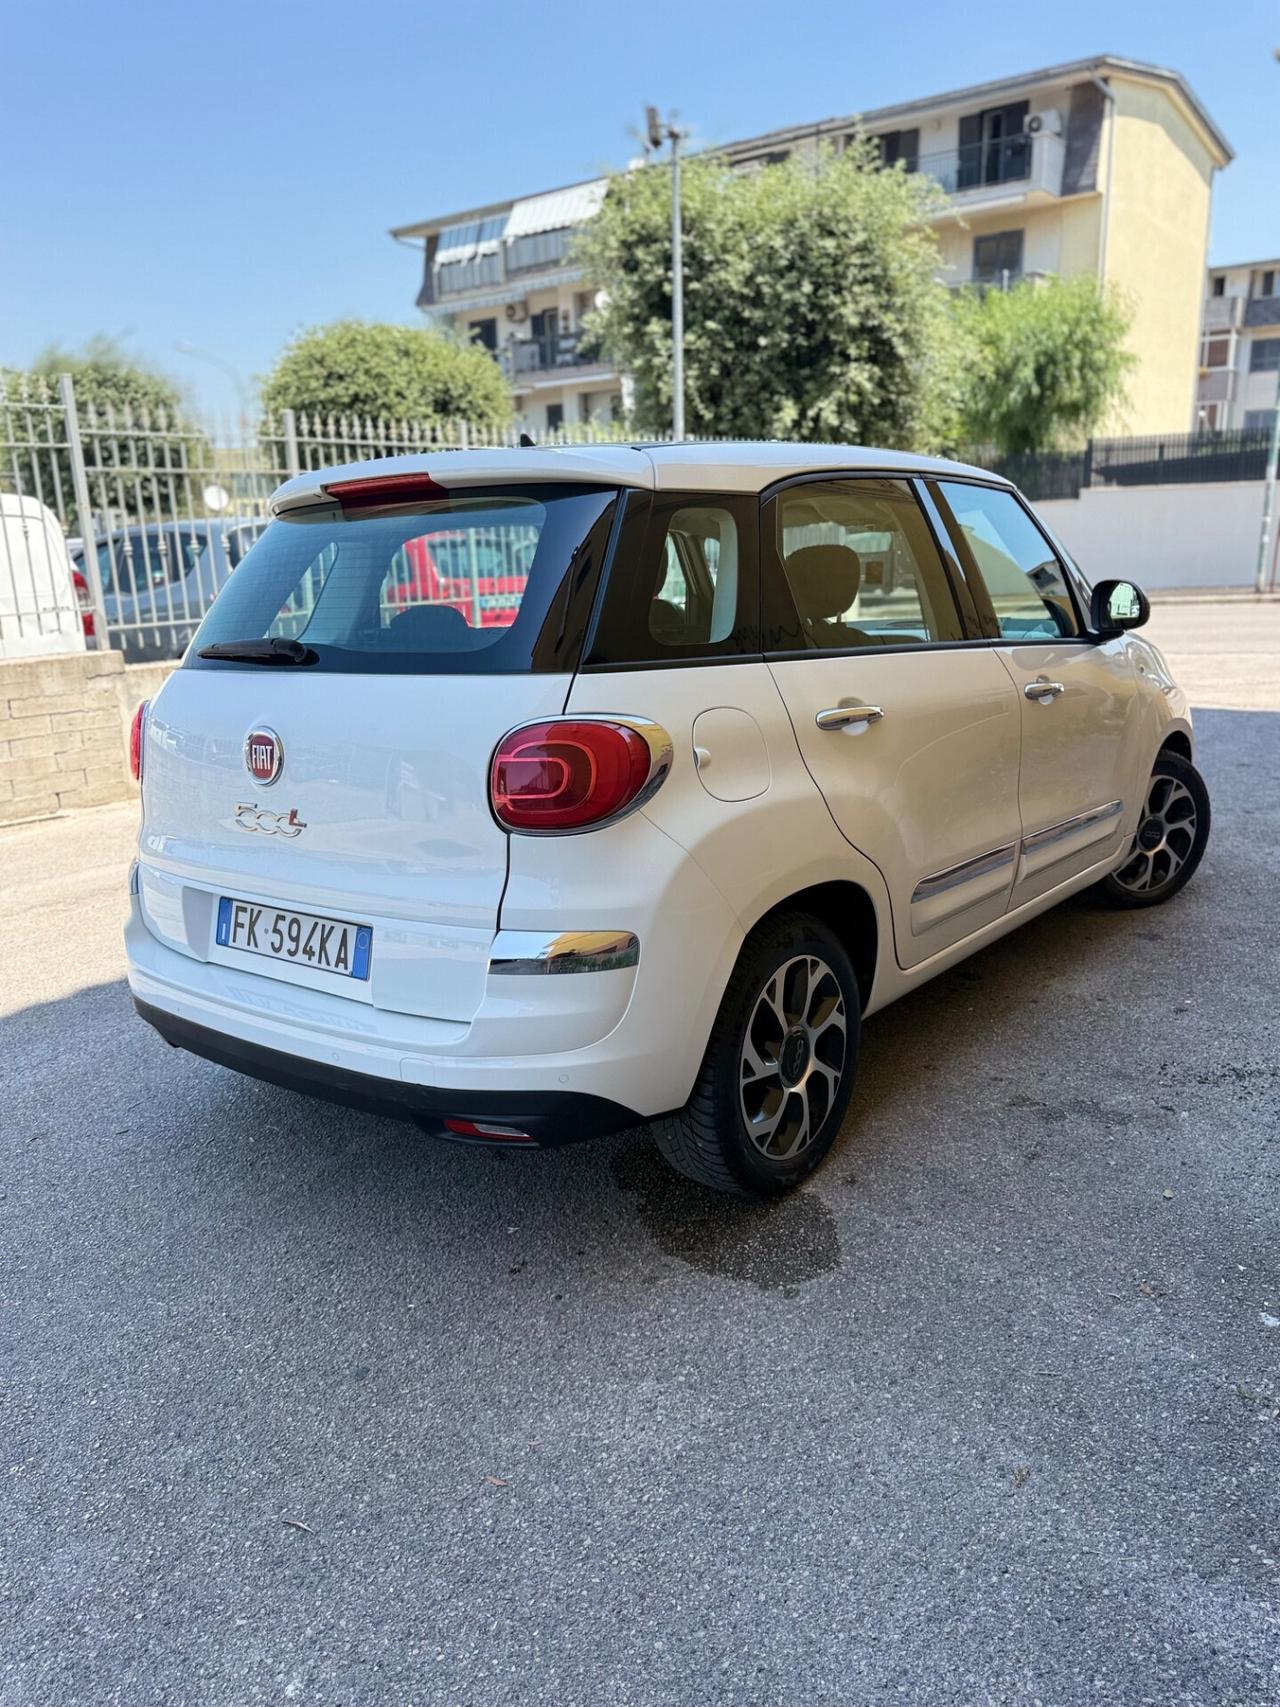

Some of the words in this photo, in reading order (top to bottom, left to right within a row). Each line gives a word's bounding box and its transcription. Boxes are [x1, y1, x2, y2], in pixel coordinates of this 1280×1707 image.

[252, 745, 272, 770] FIAT
[233, 905, 262, 948] FK
[271, 914, 348, 970] 594KA
